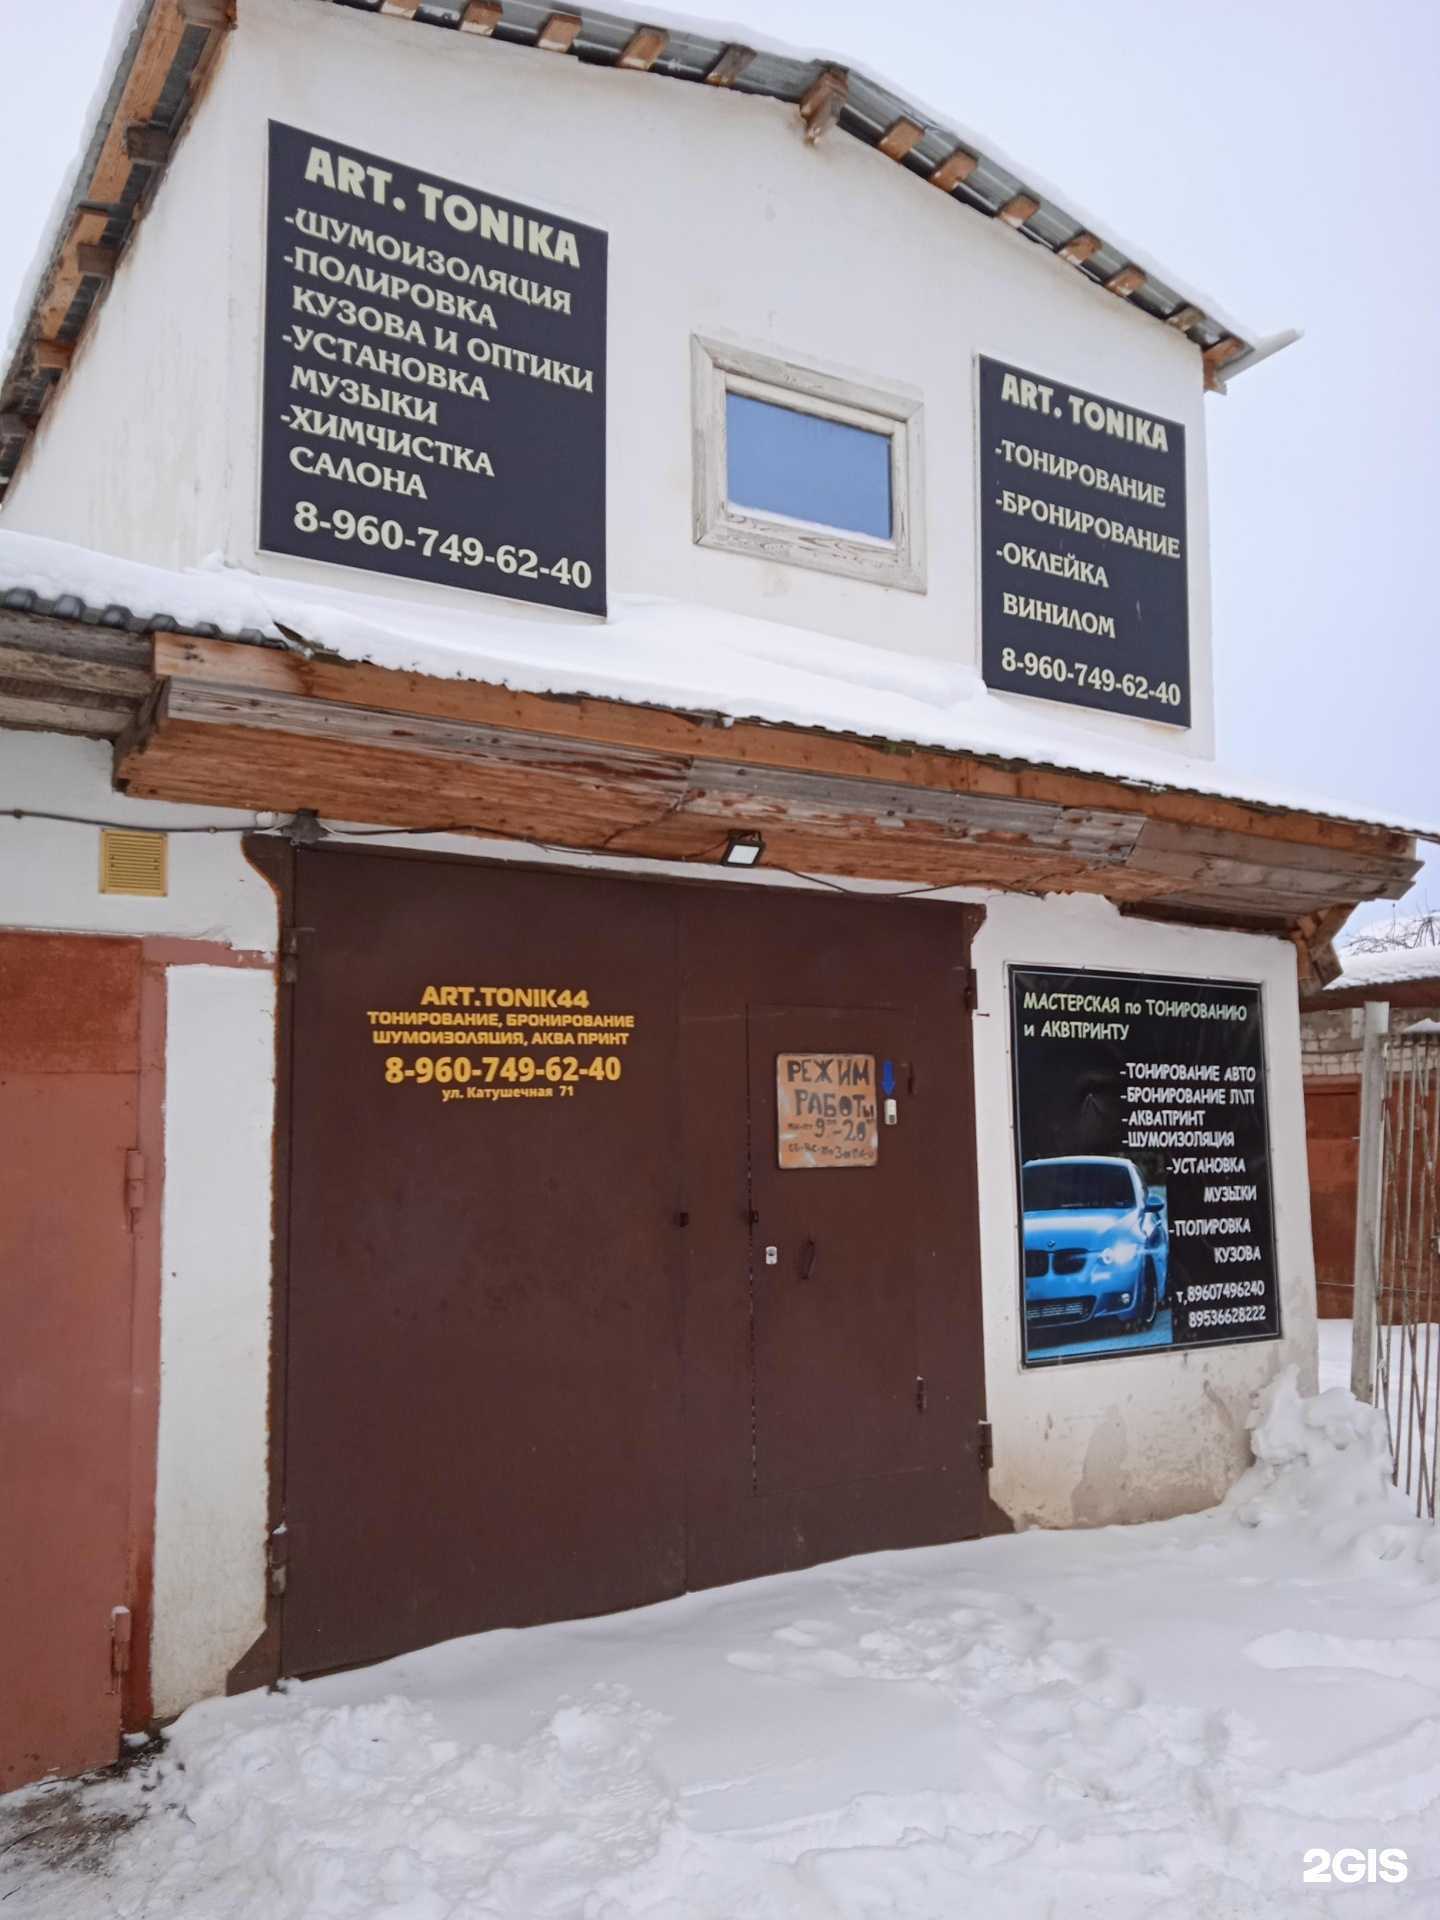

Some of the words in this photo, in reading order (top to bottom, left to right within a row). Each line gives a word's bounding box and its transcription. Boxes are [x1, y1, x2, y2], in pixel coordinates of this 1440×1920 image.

[304, 147, 406, 212] ART.
[418, 184, 580, 268] TONIKA
[285, 208, 572, 315] -ШУМОИЗОЛЯЦИЯ
[284, 247, 497, 329] -ПОЛИРОВКА
[293, 286, 426, 346] КУЗОВА
[435, 327, 458, 354] И
[467, 337, 594, 393] ОПТИКИ
[282, 326, 490, 400] -УСТАНОВКА
[291, 366, 438, 425] МУЗЫКИ
[1002, 373, 1062, 419] ART.
[1068, 395, 1168, 451] TONIKA
[281, 406, 495, 477] -ХИМЧИСТКА
[289, 446, 427, 499] САЛОНА
[995, 440, 1166, 508] -ТОНИРОВАНИЕ
[995, 490, 1181, 558] -БРОНИРОВАНИЕ
[293, 502, 592, 588] 8-960-749-62-40
[996, 541, 1108, 588] -ОКЛЕЙКА
[1003, 592, 1116, 639] ВИНИЛОМ
[1002, 648, 1181, 706] 8-960-749-62-40
[367, 1011, 503, 1028] ТОНИРОВАНИЕ,
[506, 1013, 635, 1028] БРОНИРОВАНИЕ
[1023, 992, 1119, 1014] МАСТЕРСКАЯ
[1125, 1001, 1141, 1015] по
[1146, 999, 1248, 1022] ТОНИРОВАНИЮ
[373, 1030, 529, 1046] ШУМОИЗОЛЯЦИЯ,
[532, 1032, 575, 1045] АКВА
[577, 1032, 629, 1045] ПРИНТ
[1024, 1024, 1034, 1037] и
[1041, 1020, 1129, 1040] АКВПРИНТУ
[385, 1056, 621, 1083] 8-960-749-62-40
[786, 1059, 870, 1085] РЕЖИМ
[1120, 1062, 1220, 1082] -ТОНИРОВАНИЕ
[1224, 1067, 1256, 1082] АВТО
[442, 1088, 463, 1102] ул.
[467, 1087, 552, 1101] Катушечная
[559, 1086, 574, 1097] 71
[1120, 1087, 1226, 1104] -БРОНИРОВАНИЕ
[1122, 1110, 1206, 1126] -АКВАПРИНТ
[1122, 1131, 1234, 1148] -ШУМОИЗОЛЯЦИЯ
[1166, 1157, 1246, 1175] -УСТАНОВКА
[1204, 1185, 1257, 1203] МУЗЫКИ
[1169, 1219, 1251, 1236] -ПОЛИРОВКА
[1214, 1246, 1261, 1263] КУЗОВА
[1188, 1305, 1266, 1328] 89536628222
